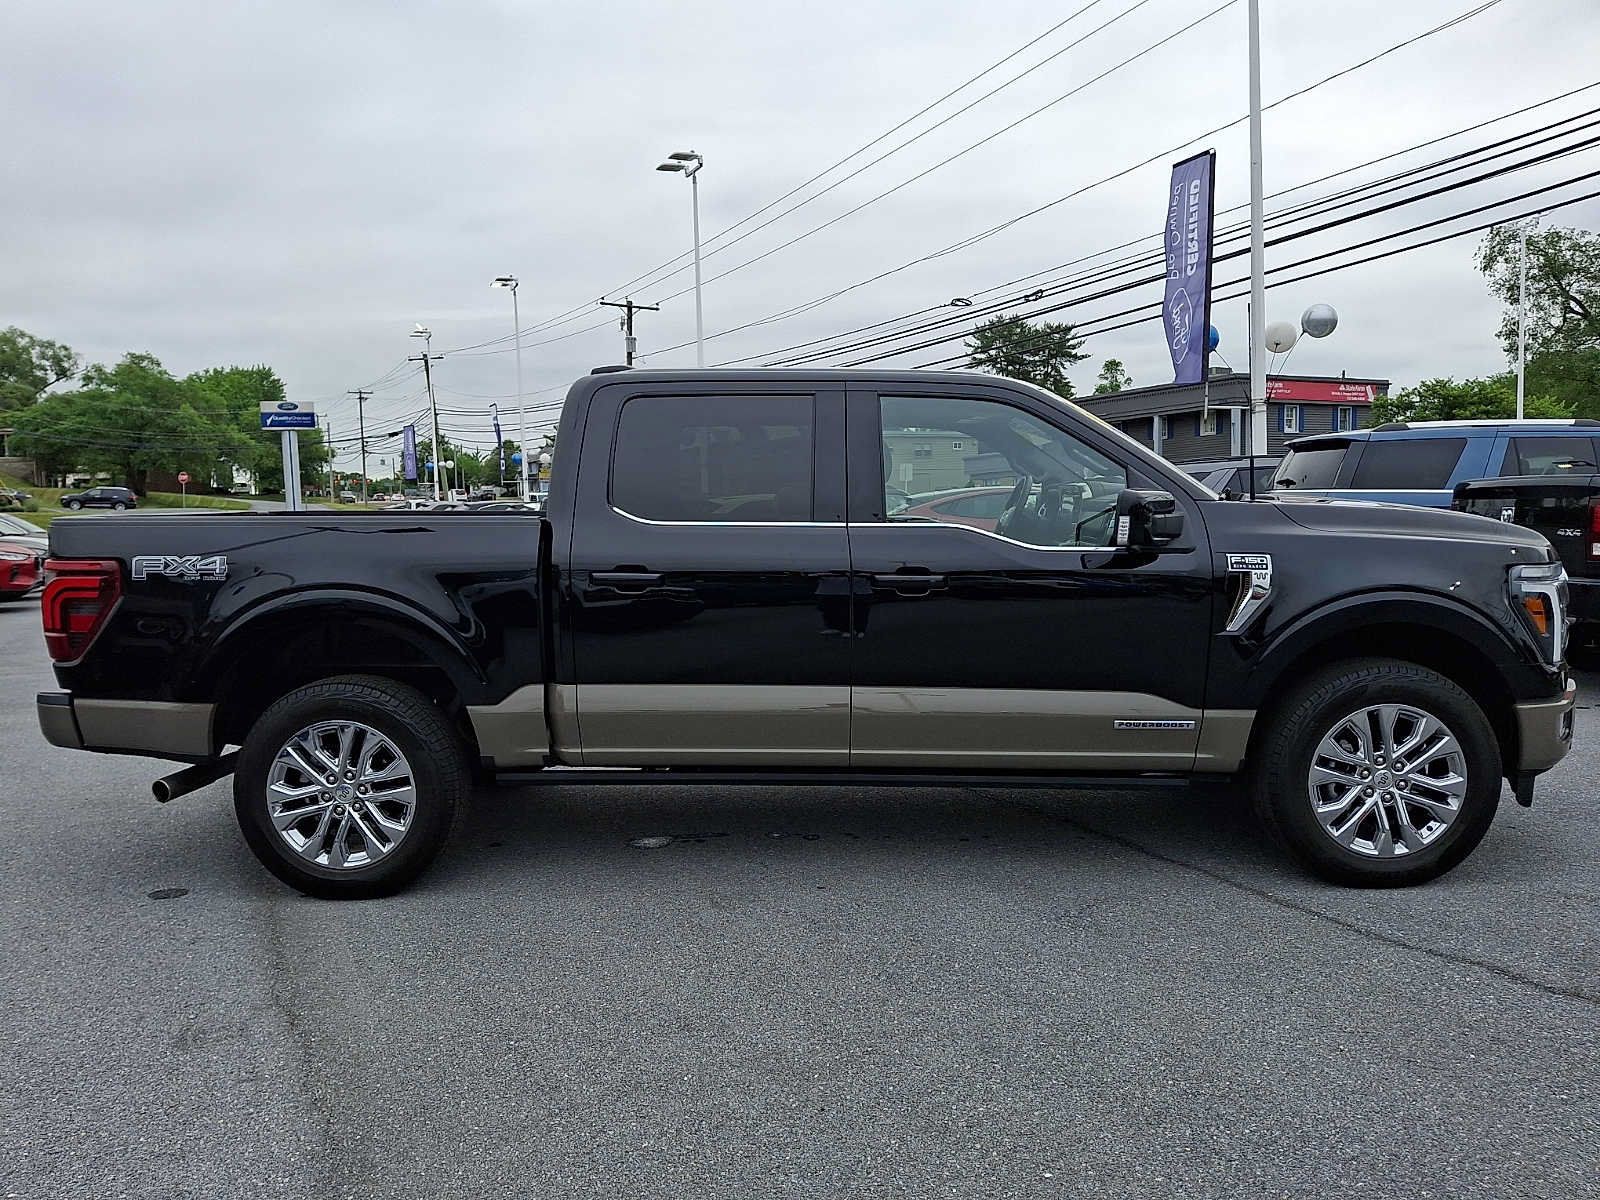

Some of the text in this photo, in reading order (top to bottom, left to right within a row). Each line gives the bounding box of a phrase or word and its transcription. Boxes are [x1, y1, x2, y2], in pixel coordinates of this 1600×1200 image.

[1230, 556, 1268, 564] F-150
[131, 555, 228, 581] FX4
[1117, 721, 1194, 729] POWERBOOST
